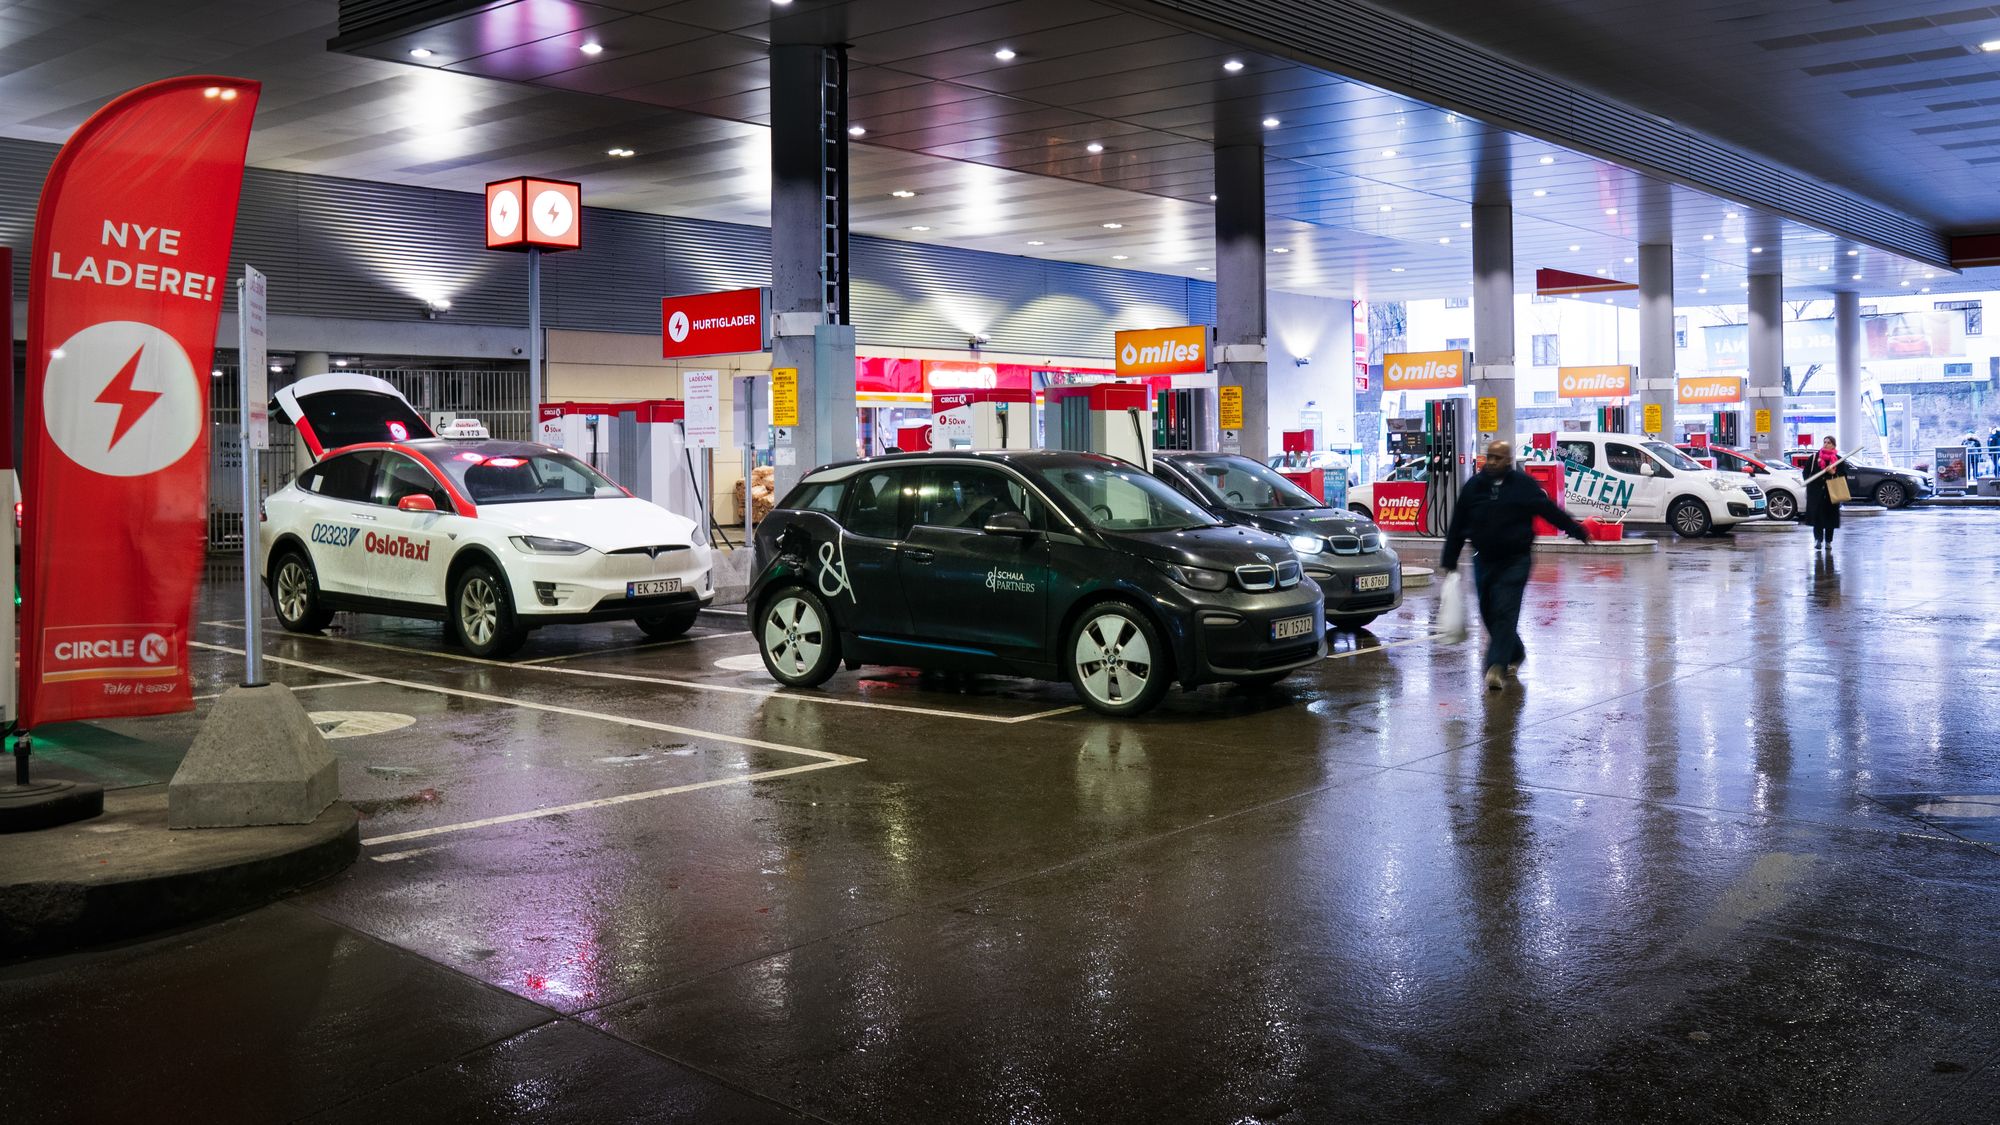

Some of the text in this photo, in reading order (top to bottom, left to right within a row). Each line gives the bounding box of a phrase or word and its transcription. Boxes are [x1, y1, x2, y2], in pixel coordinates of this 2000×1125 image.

[101, 219, 181, 256] NYE
[51, 251, 216, 302] LADERE!
[692, 314, 756, 331] HURTIGLADER
[1138, 340, 1200, 364] miles
[1403, 360, 1458, 381] miles
[1576, 373, 1626, 391] miles
[1693, 383, 1737, 398] miles
[940, 396, 959, 404] CIRCLE
[1387, 496, 1420, 507] miles
[1379, 507, 1419, 520] PLUS
[311, 522, 348, 547] 02323
[364, 531, 431, 562] OsloTaxi
[997, 570, 1025, 581] SCHALA
[1360, 577, 1369, 588] EK
[637, 580, 679, 595] EK 25137
[996, 580, 1036, 593] PARTNERS
[1278, 618, 1311, 636] EV 15212
[54, 635, 167, 661] CIRCLE K
[104, 682, 130, 695] Take
